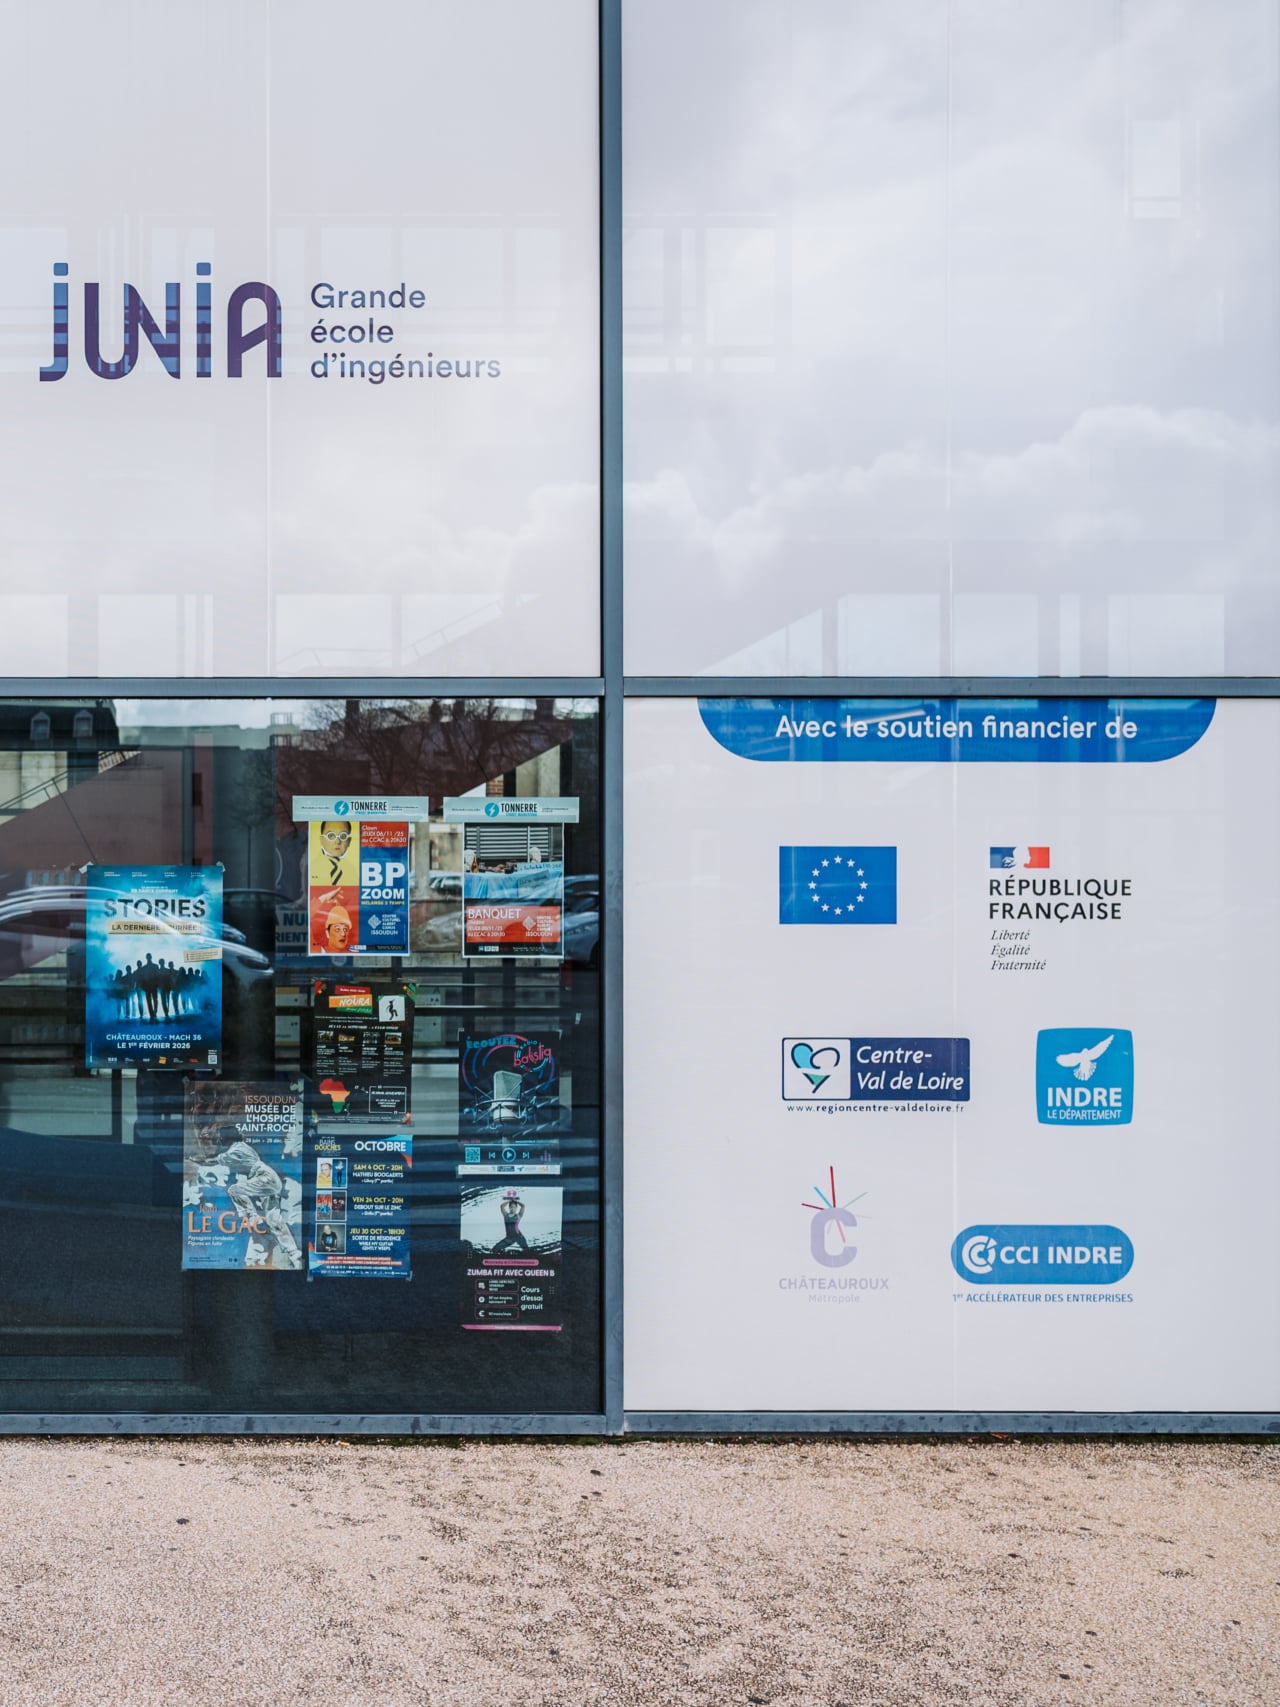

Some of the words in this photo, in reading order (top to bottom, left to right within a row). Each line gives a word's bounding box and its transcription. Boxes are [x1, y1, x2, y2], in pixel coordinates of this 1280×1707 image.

[310, 282, 426, 309] Grande
[310, 317, 395, 344] école
[310, 351, 502, 385] d'ingénieurs
[775, 717, 840, 739] Avec
[845, 715, 868, 739] le
[877, 715, 973, 739] soutien
[982, 715, 1097, 739] financier
[1105, 715, 1138, 739] de
[350, 801, 388, 811] TONNERRE
[501, 803, 538, 812] TONNERRE
[361, 862, 406, 887] BP
[988, 875, 1133, 900] RÉPUBLIQUE
[361, 888, 405, 900] ZOOM
[104, 898, 206, 917] STORIES
[468, 908, 521, 919] BANQUET
[988, 902, 1122, 923] FRANÇAISE
[124, 922, 160, 931] DERNIÈRE
[990, 929, 1031, 942] Liberté
[990, 942, 1031, 957] Égalité
[990, 958, 1047, 971] Fraternité
[339, 997, 370, 1007] NOURA
[106, 1032, 162, 1041] CHÂTEAUROUX
[139, 1041, 171, 1049] FÉVRIER
[856, 1045, 933, 1065] Centre-
[856, 1071, 885, 1091] Val
[889, 1073, 912, 1091] de
[917, 1071, 964, 1091] Loire
[245, 1095, 296, 1104] ISSOUDUN
[1047, 1087, 1122, 1108] INDRE
[244, 1103, 280, 1113] MUSÉE
[282, 1105, 296, 1113] DE
[786, 1103, 965, 1113] www.regioncentre-valdeloire.fr
[1047, 1110, 1058, 1120] LE
[1059, 1108, 1122, 1120] DÉPARTEMENT
[246, 1114, 296, 1122] L'HOSPICE
[235, 1123, 296, 1132] SAINT-ROCH
[354, 1141, 407, 1152] OCTOBRE
[999, 1246, 1039, 1265] CCI
[1048, 1246, 1123, 1265] INDRE
[525, 1269, 548, 1277] QUEEN
[778, 1274, 890, 1290] CHÂTEAUROUX
[808, 1293, 861, 1304] Métropole
[966, 1292, 1042, 1303] ACCÉLÉRATEUR
[1044, 1294, 1064, 1303] DES
[1066, 1294, 1134, 1303] ENTREPRISES
